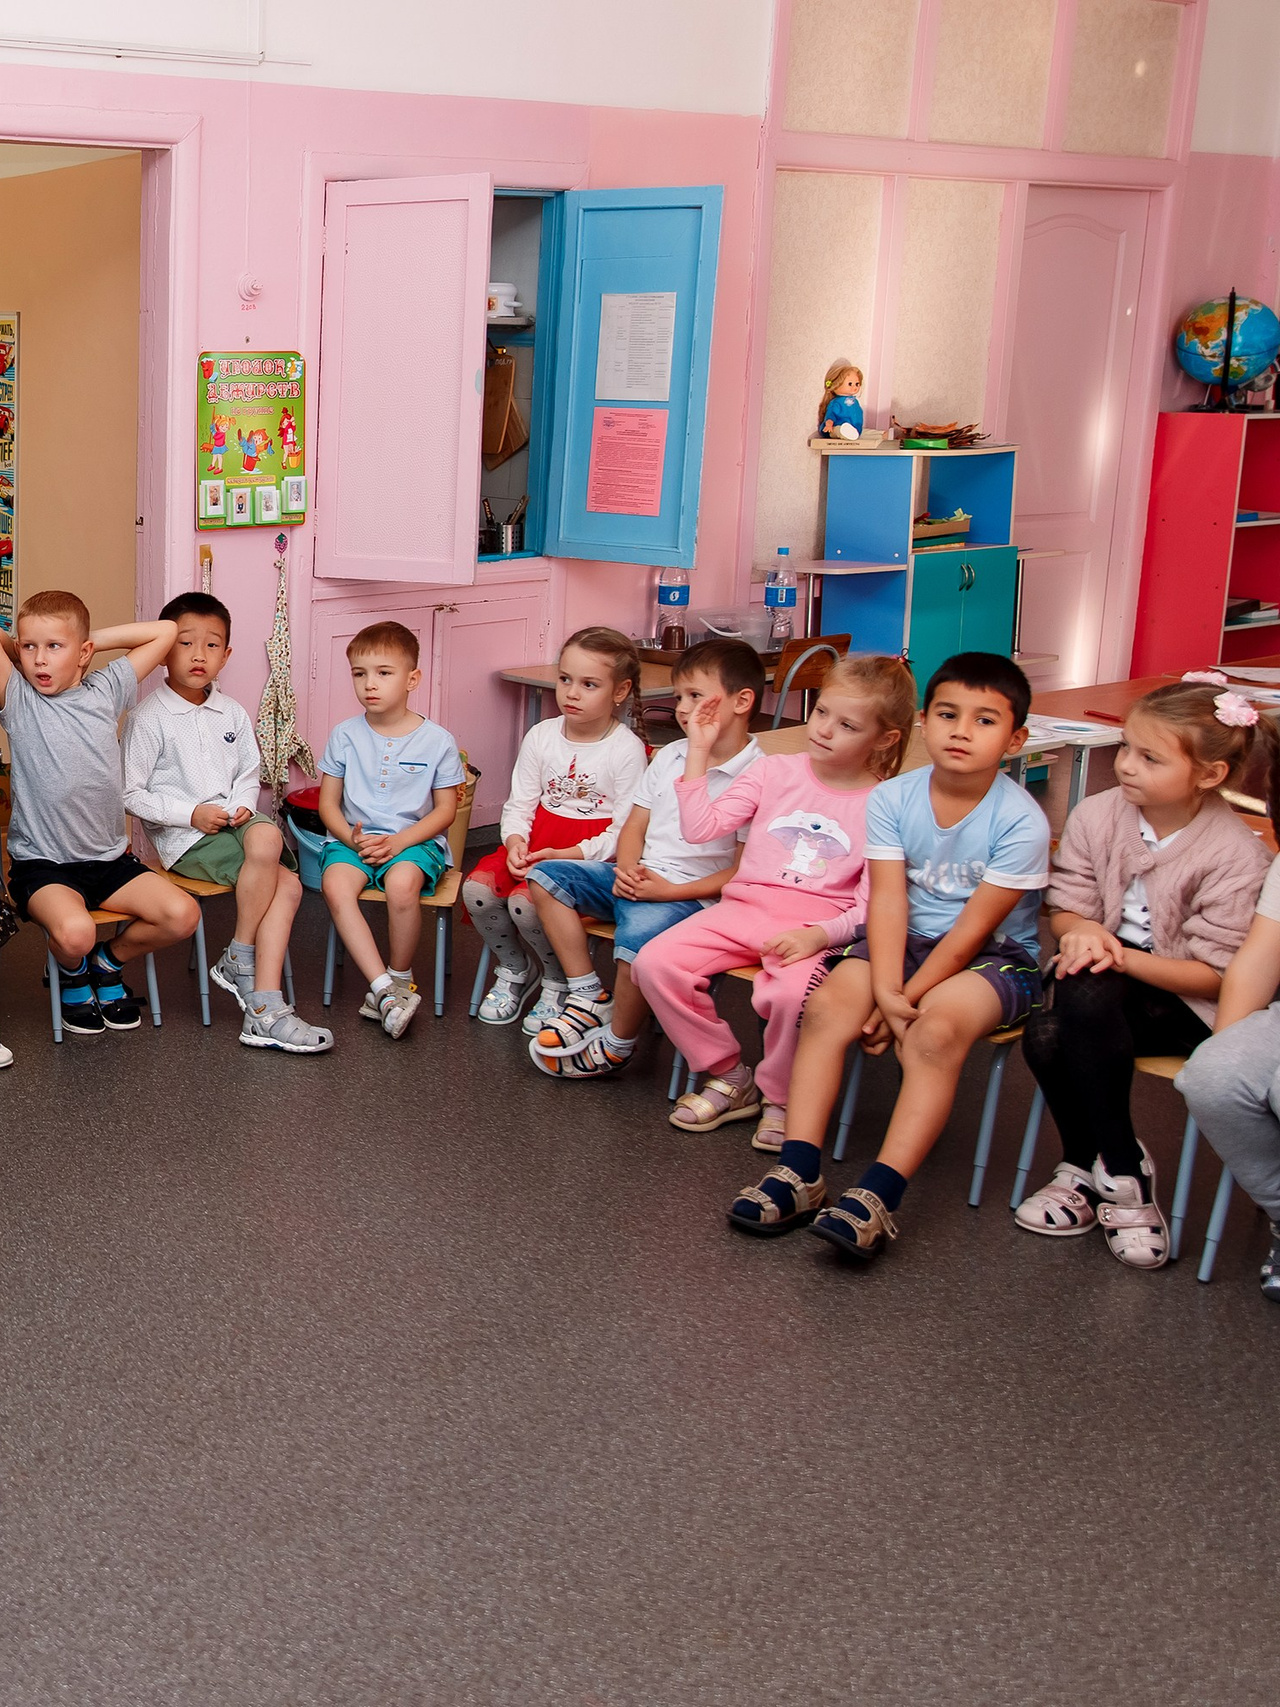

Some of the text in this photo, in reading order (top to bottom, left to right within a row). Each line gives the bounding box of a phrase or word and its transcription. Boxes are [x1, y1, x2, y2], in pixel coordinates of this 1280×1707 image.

[218, 358, 287, 379] УГОЛОК
[206, 381, 301, 404] ДЕЖУРСТВ
[1075, 750, 1083, 763] 2
[1021, 762, 1028, 775] 2
